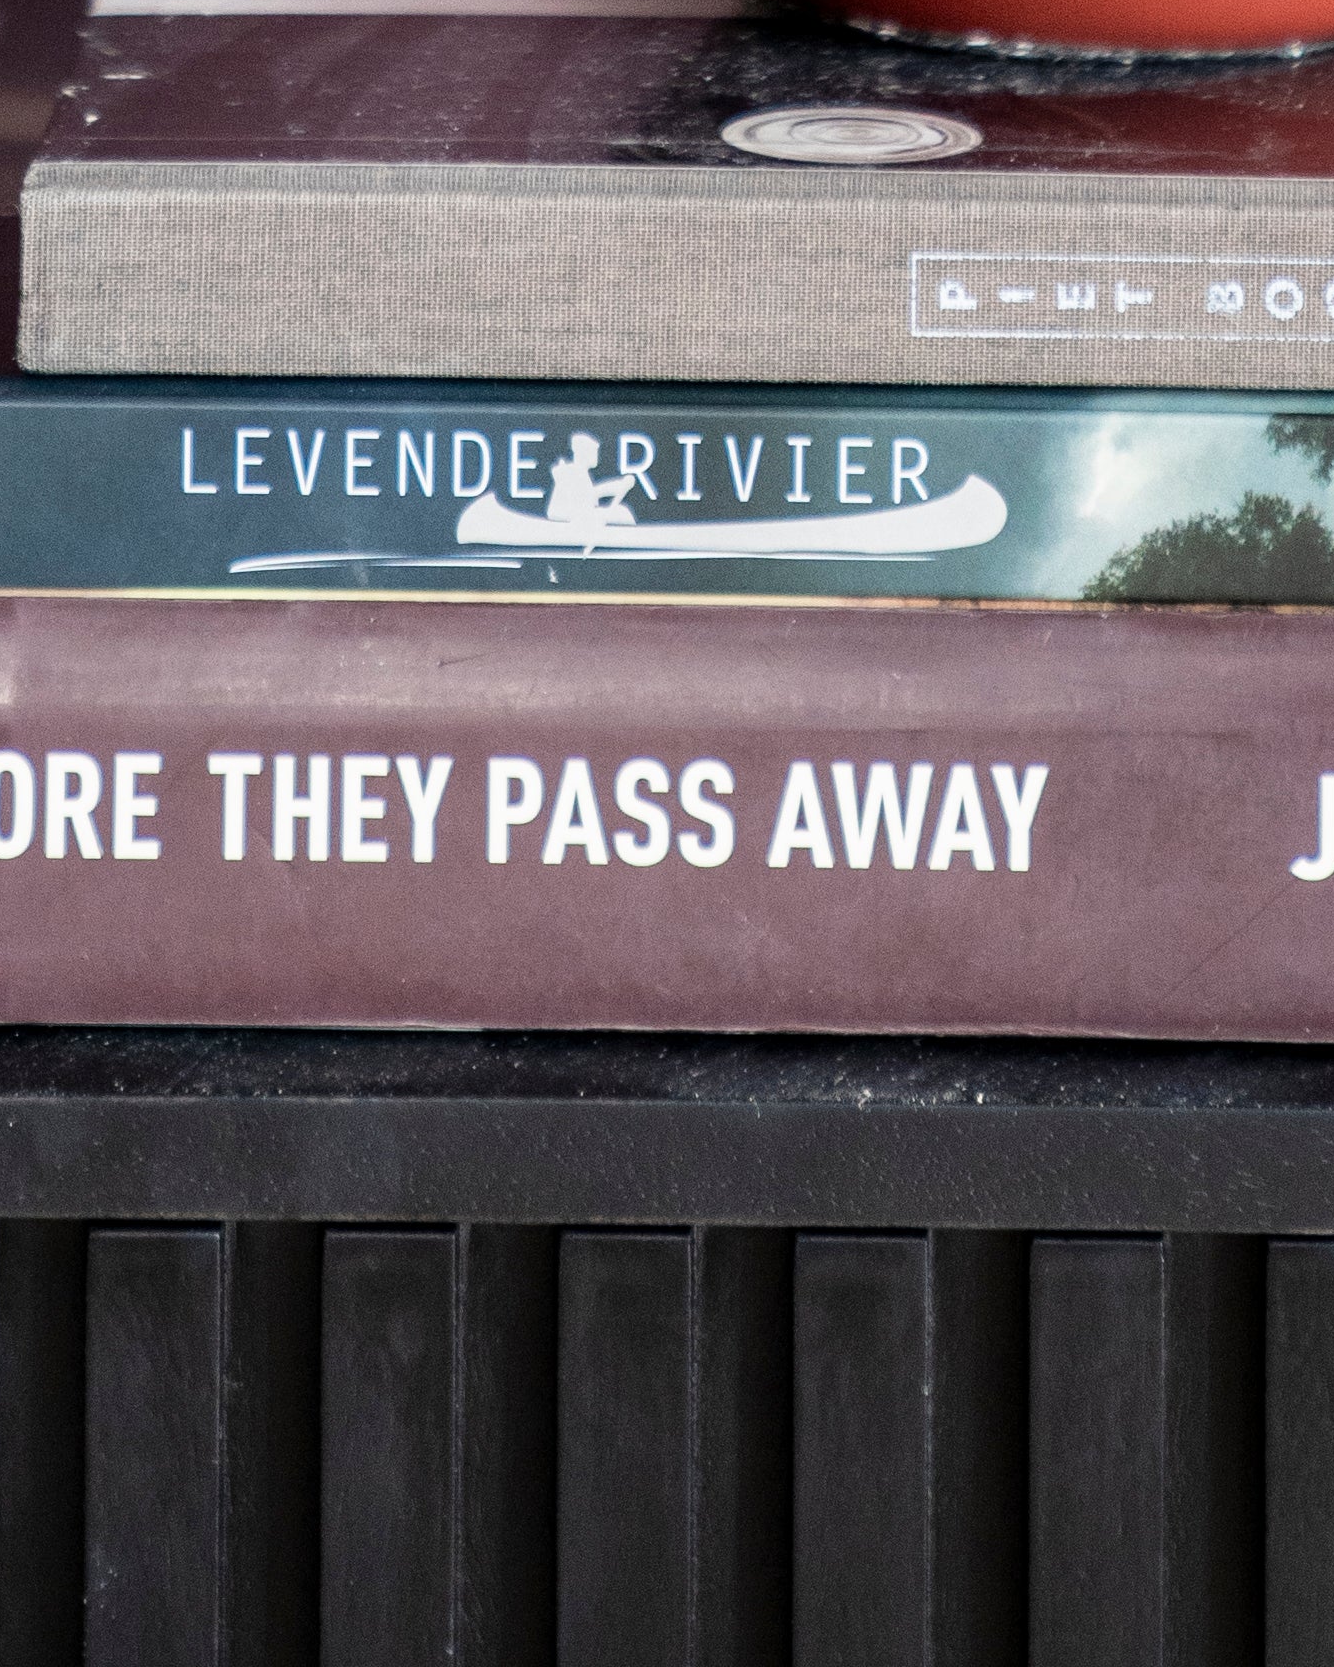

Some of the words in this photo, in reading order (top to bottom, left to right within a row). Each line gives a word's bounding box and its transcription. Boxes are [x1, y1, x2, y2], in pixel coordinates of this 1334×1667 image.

[937, 277, 1155, 315] PIET
[180, 427, 546, 499] LEVENDE
[617, 431, 931, 505] RIVIER
[208, 753, 454, 864] THEY
[487, 757, 735, 868] PASS
[766, 761, 1050, 872] AWAY
